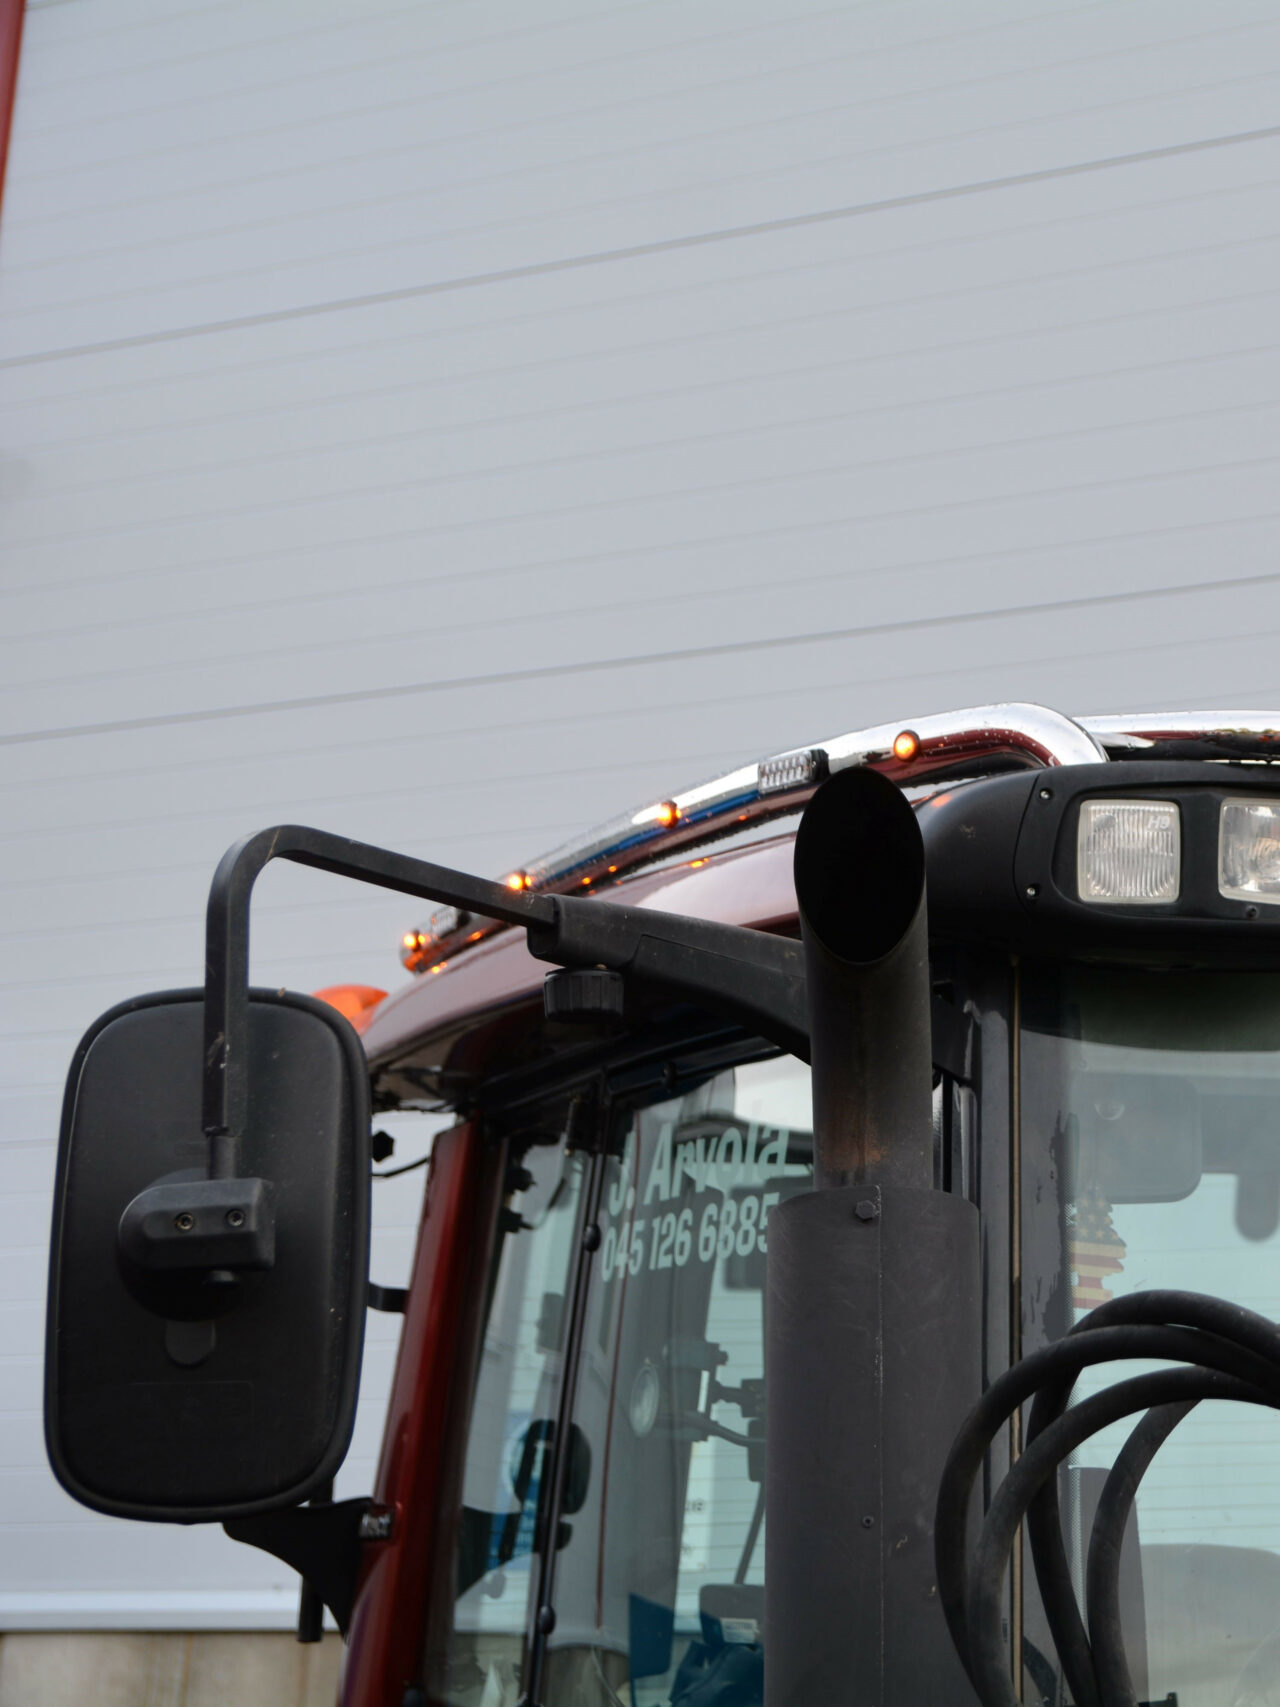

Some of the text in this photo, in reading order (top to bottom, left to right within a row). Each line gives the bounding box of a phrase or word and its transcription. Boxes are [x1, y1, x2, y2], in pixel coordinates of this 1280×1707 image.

[643, 1122, 789, 1205] Arvola
[601, 1192, 780, 1283] 045 126 6885
